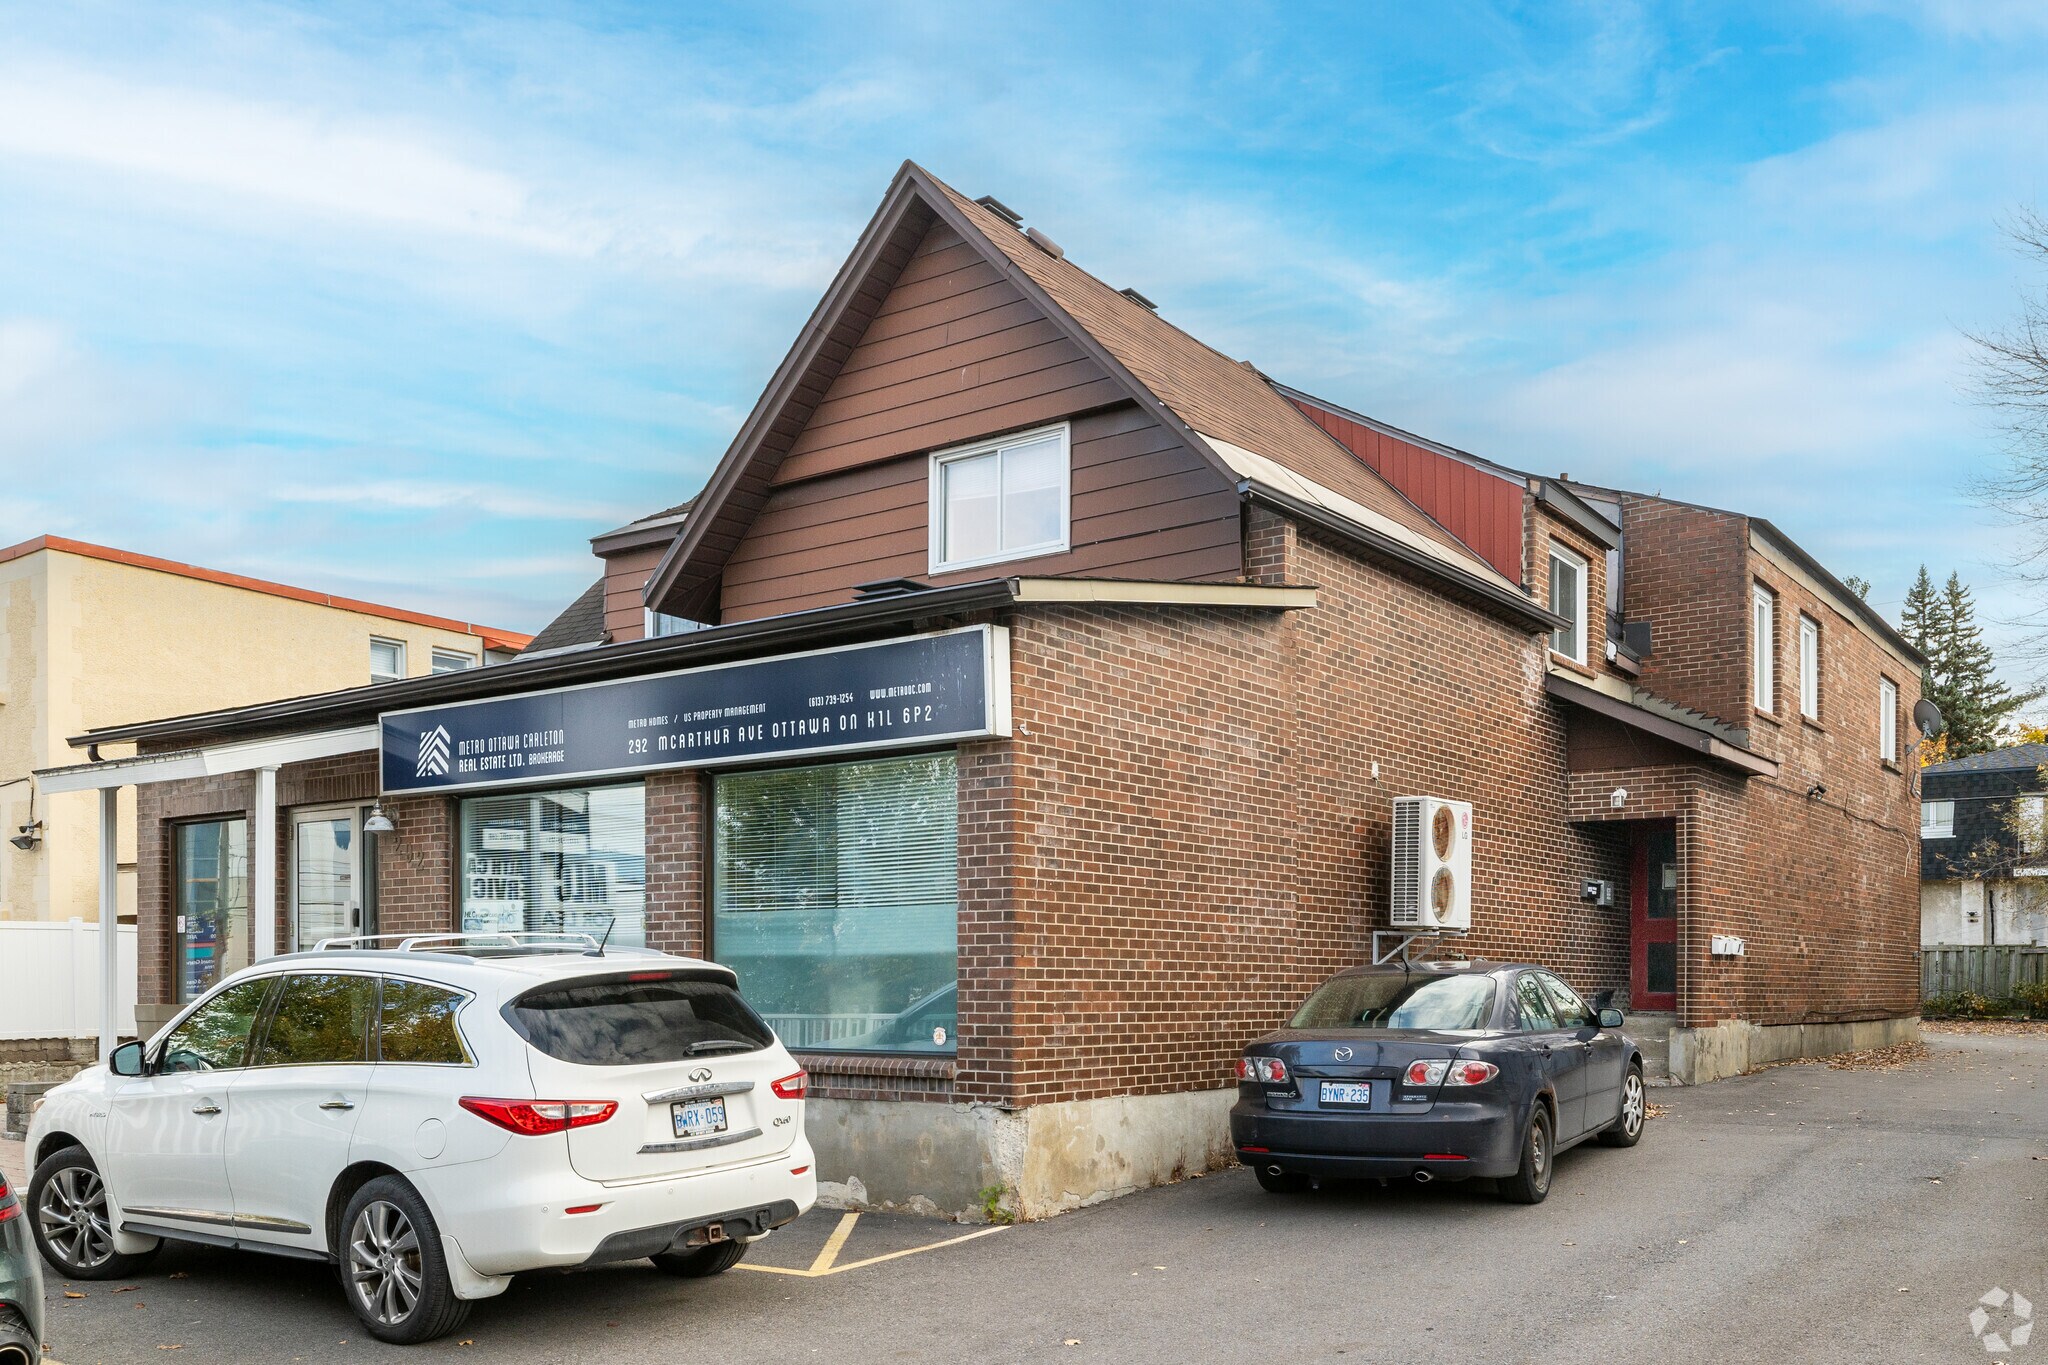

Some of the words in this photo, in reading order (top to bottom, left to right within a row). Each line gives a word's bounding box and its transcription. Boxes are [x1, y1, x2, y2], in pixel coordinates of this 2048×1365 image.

[825, 692, 854, 705] 739-1254
[628, 718, 648, 729] METRO
[648, 715, 669, 727] HOMES
[683, 712, 692, 723] US
[693, 708, 723, 721] PROPERTY
[724, 702, 767, 717] MANAGEMENT
[628, 738, 648, 754] 292
[658, 728, 730, 751] MCARTHUR
[738, 724, 763, 742] AVE
[772, 716, 830, 738] OTTAWA
[839, 713, 857, 731] ON
[867, 709, 892, 728] K1L
[902, 704, 932, 724] 6P2
[458, 738, 485, 756] METRO
[488, 734, 520, 753] OTTAWA
[523, 729, 564, 748] CARLETON
[458, 757, 478, 773] REAL
[480, 755, 506, 771] ESTATE
[509, 753, 525, 768] LTD.
[528, 750, 565, 765] BROKERAGE
[1350, 1089, 1369, 1103] 235
[705, 1106, 725, 1124] 059
